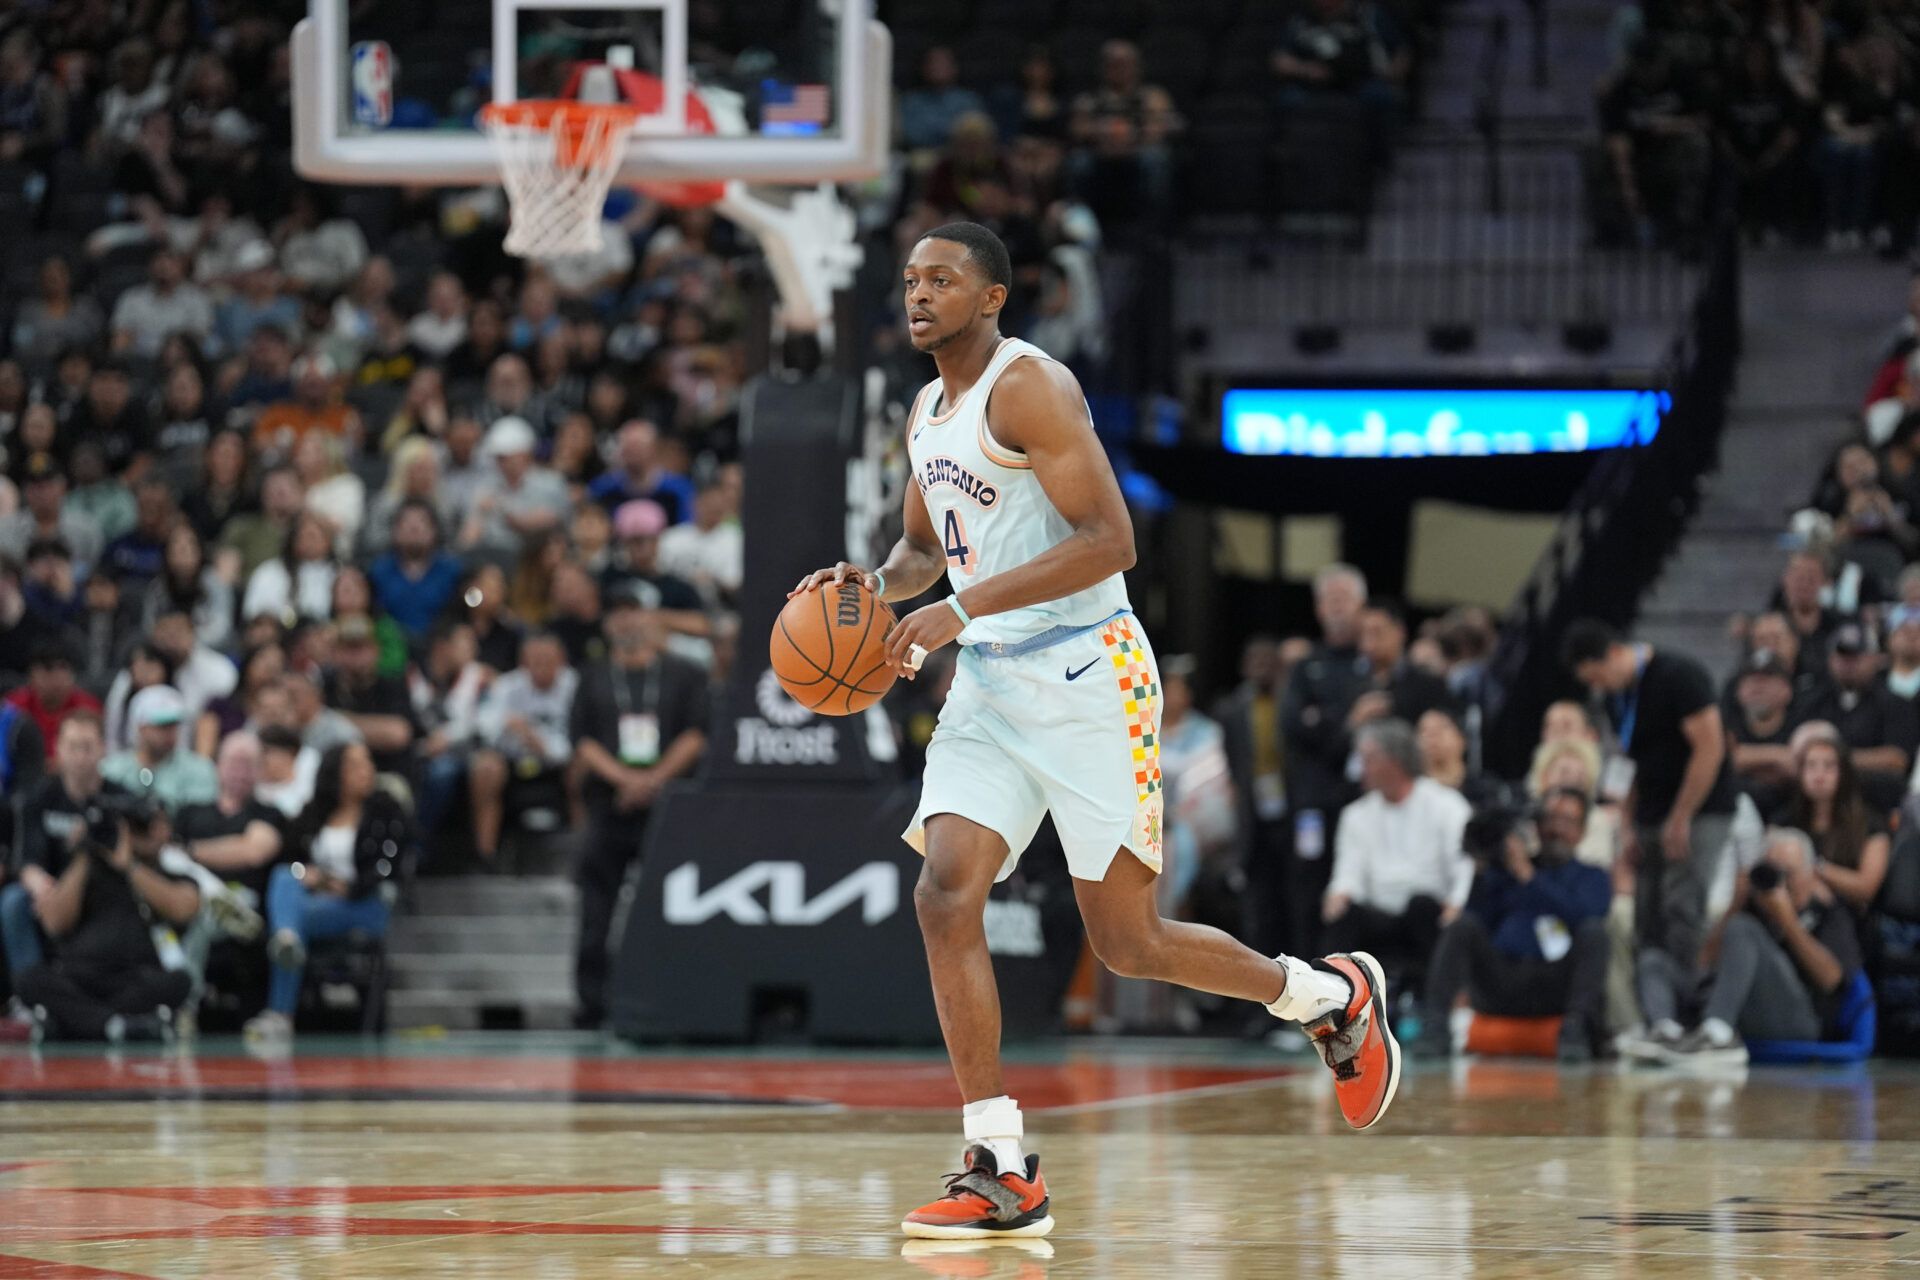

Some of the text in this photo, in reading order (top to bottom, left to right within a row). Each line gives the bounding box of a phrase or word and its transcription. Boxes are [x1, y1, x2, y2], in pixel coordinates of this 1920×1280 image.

[926, 458, 997, 507] ANTONIO
[944, 508, 970, 567] 4
[662, 860, 899, 925] KIA
